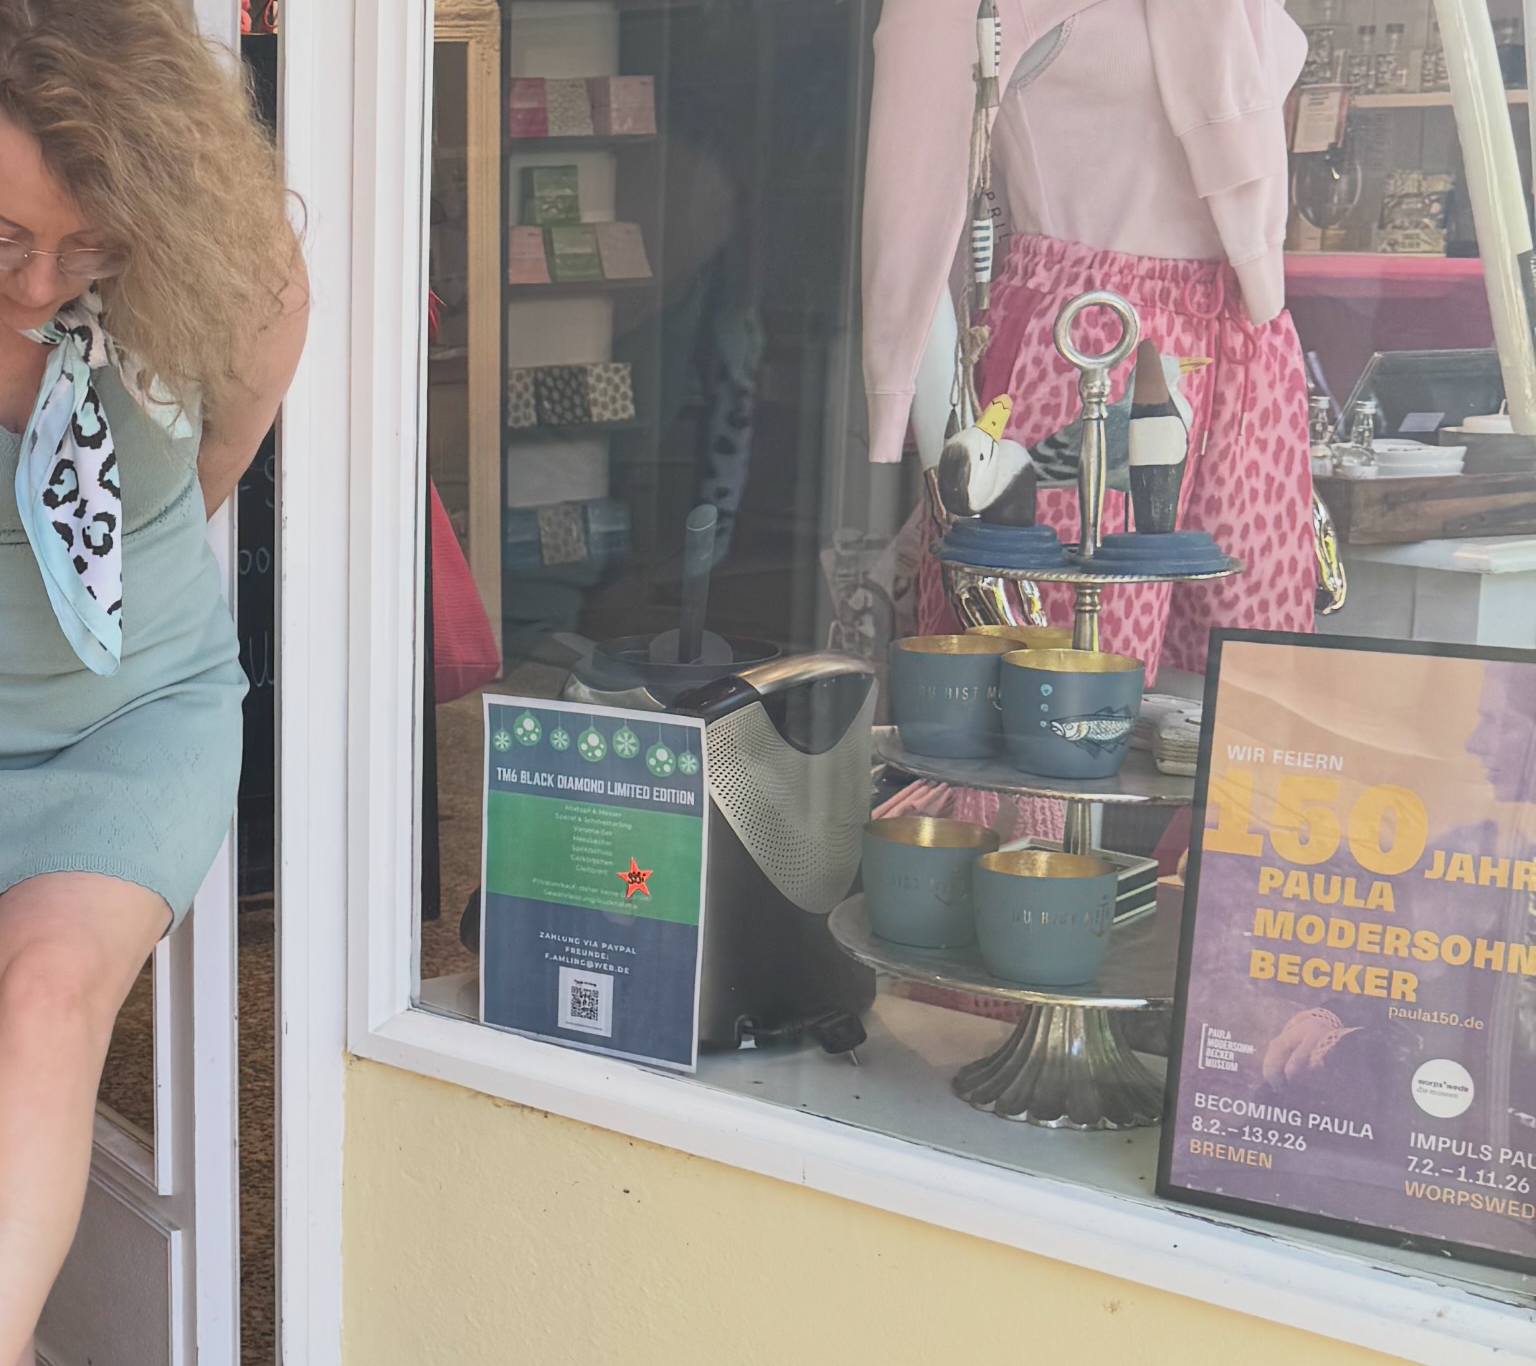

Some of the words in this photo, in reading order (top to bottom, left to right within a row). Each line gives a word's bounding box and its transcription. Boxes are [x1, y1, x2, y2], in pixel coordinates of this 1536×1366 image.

[1226, 744, 1265, 763] WIR
[1272, 749, 1344, 771] FEIERN
[496, 767, 518, 783] TM6
[520, 770, 554, 788] BLACK
[557, 774, 605, 795] DIAMOND
[607, 780, 650, 800] LIMITED
[653, 787, 695, 805] EDITION
[1202, 769, 1428, 875] 150
[1258, 866, 1396, 913] PAULA
[539, 931, 581, 945] ZAHLUNG
[583, 939, 598, 948] VIA
[601, 942, 637, 955] PAYPAL
[1253, 907, 1536, 977] MODERSOHN
[1249, 949, 1419, 1003] BECKER
[1207, 1027, 1231, 1040] PAULA
[1388, 1005, 1485, 1031] paula150.de
[1194, 1092, 1302, 1127] BECOMING
[1308, 1113, 1374, 1140] PAULA
[1189, 1139, 1273, 1169] BREMEN
[1409, 1131, 1493, 1161] IMPULS
